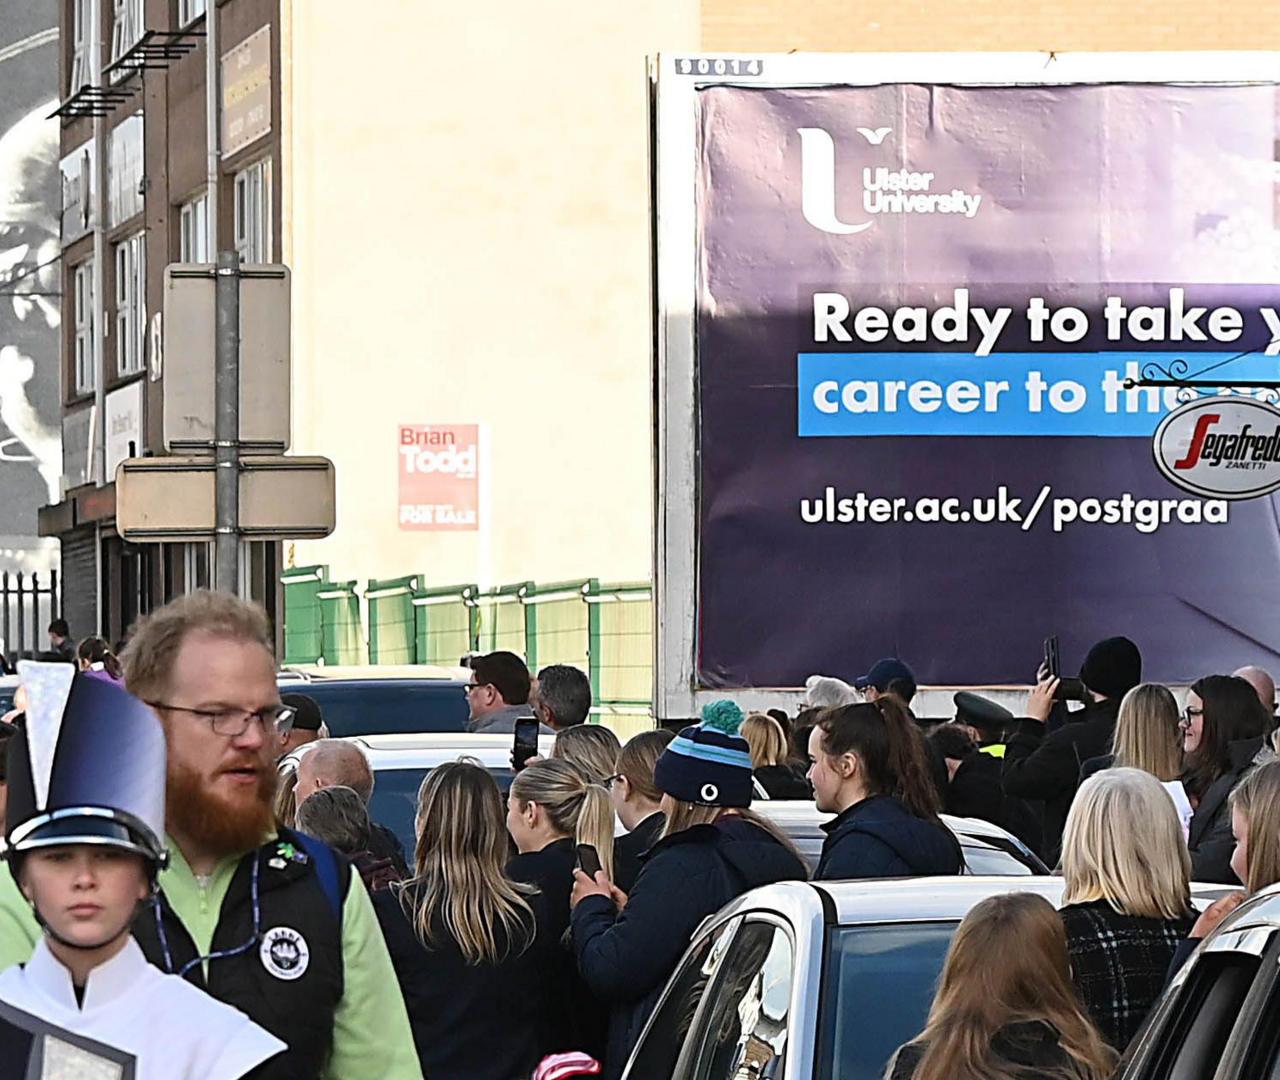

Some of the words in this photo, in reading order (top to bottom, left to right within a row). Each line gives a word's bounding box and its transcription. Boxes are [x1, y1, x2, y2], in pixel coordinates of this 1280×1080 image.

[863, 167, 934, 192] Ulster
[863, 189, 981, 218] University
[812, 288, 1012, 356] Ready
[1027, 298, 1088, 342] to
[1104, 288, 1243, 342] take
[812, 378, 1009, 415] career
[1025, 370, 1087, 415] to
[400, 428, 456, 446] Brian
[399, 444, 477, 473] Todd
[1225, 461, 1266, 470] ZANETTI
